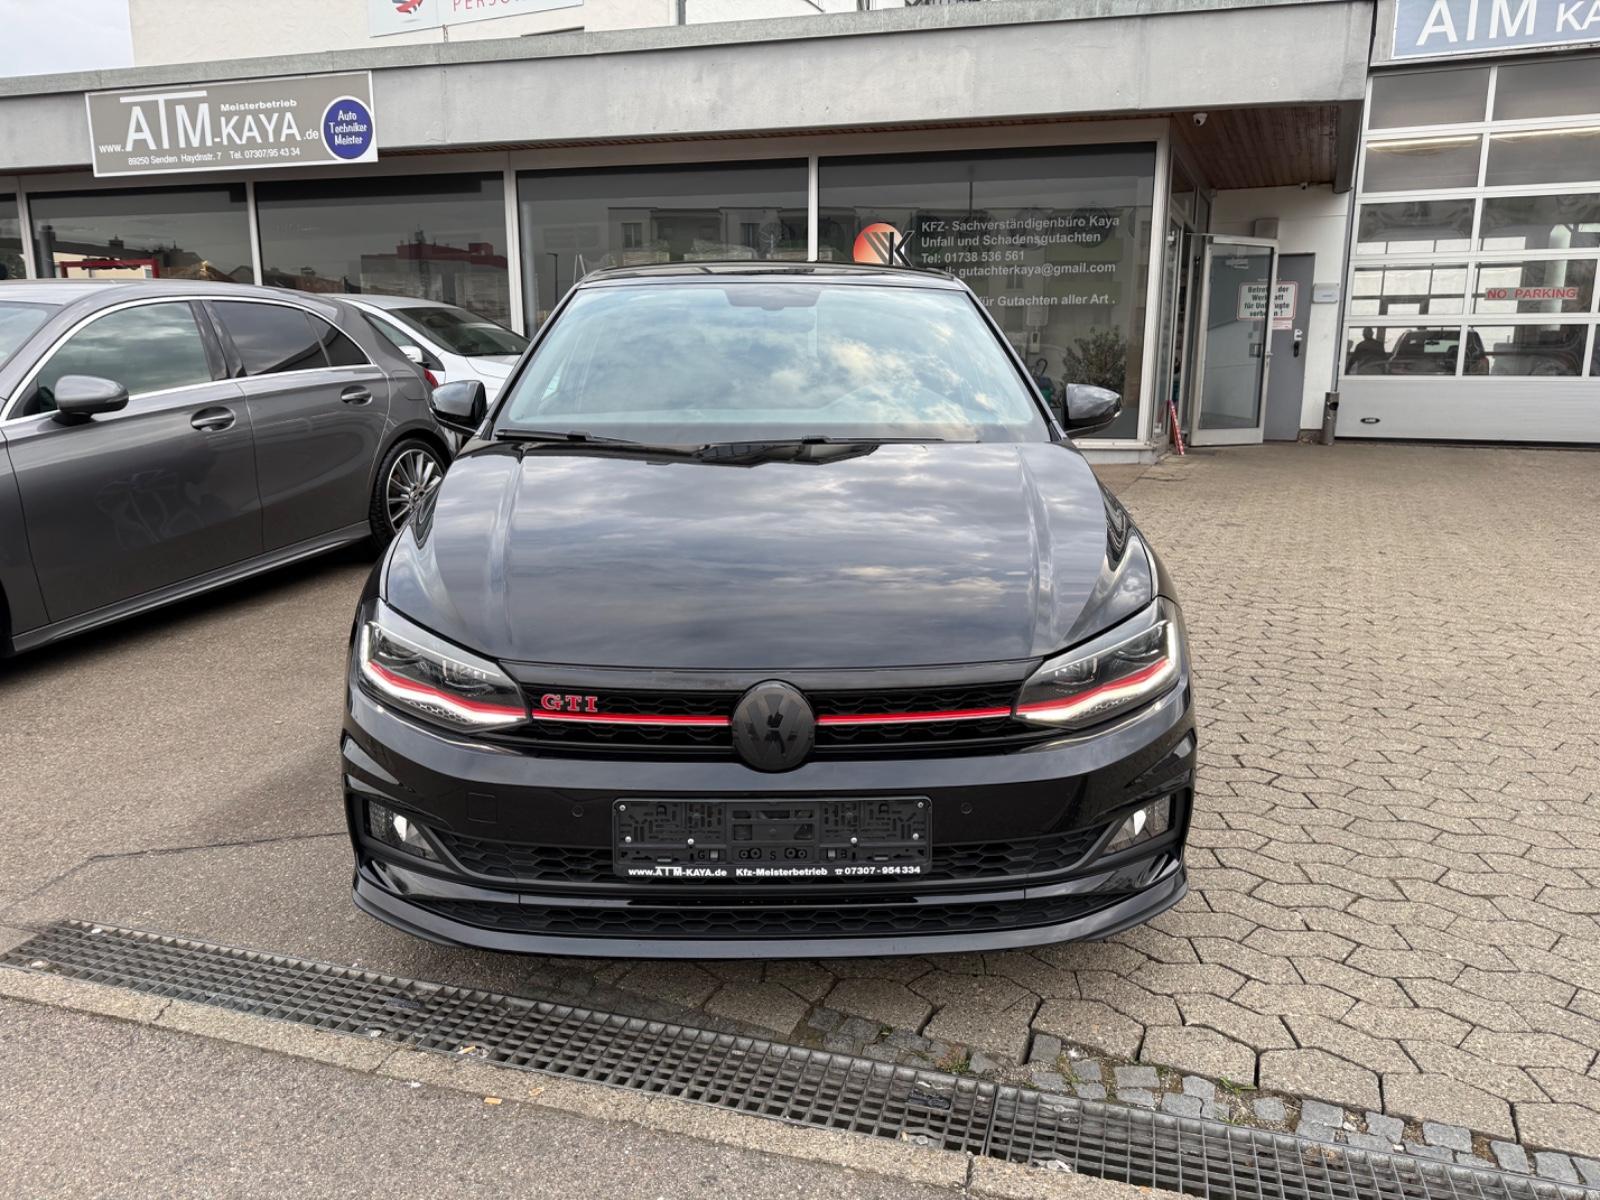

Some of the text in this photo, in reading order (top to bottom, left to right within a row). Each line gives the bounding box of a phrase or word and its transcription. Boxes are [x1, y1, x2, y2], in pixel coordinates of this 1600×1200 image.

[453, 0, 508, 12] PER
[220, 99, 297, 112] Meisterbetrieb
[337, 110, 357, 121] Auto
[328, 121, 367, 134] Techniker
[335, 133, 363, 146] Meister
[150, 154, 178, 165] Senden
[181, 152, 216, 163] Haydnstr.
[217, 151, 222, 160] 7
[229, 150, 243, 159] Tel.
[279, 147, 290, 157] 43
[290, 147, 300, 156] 34
[921, 216, 1120, 233] KFZ- Sachverständigenbüro Kaya
[921, 232, 1101, 248] Unfall und Schadensgutachten
[921, 250, 1024, 264] Tel: 01738 536 561
[959, 261, 1116, 279] gutachterkaya@gmail.com
[997, 295, 1058, 307] Gutachten
[1061, 294, 1088, 305] aller
[1089, 293, 1109, 305] Art
[1487, 288, 1577, 299] NO PARKING
[541, 693, 598, 712] GTI
[628, 866, 727, 877] www.ATM-KAYA.de
[735, 867, 828, 877] Kfz-Meisterbetrieb
[844, 866, 876, 875] 07307
